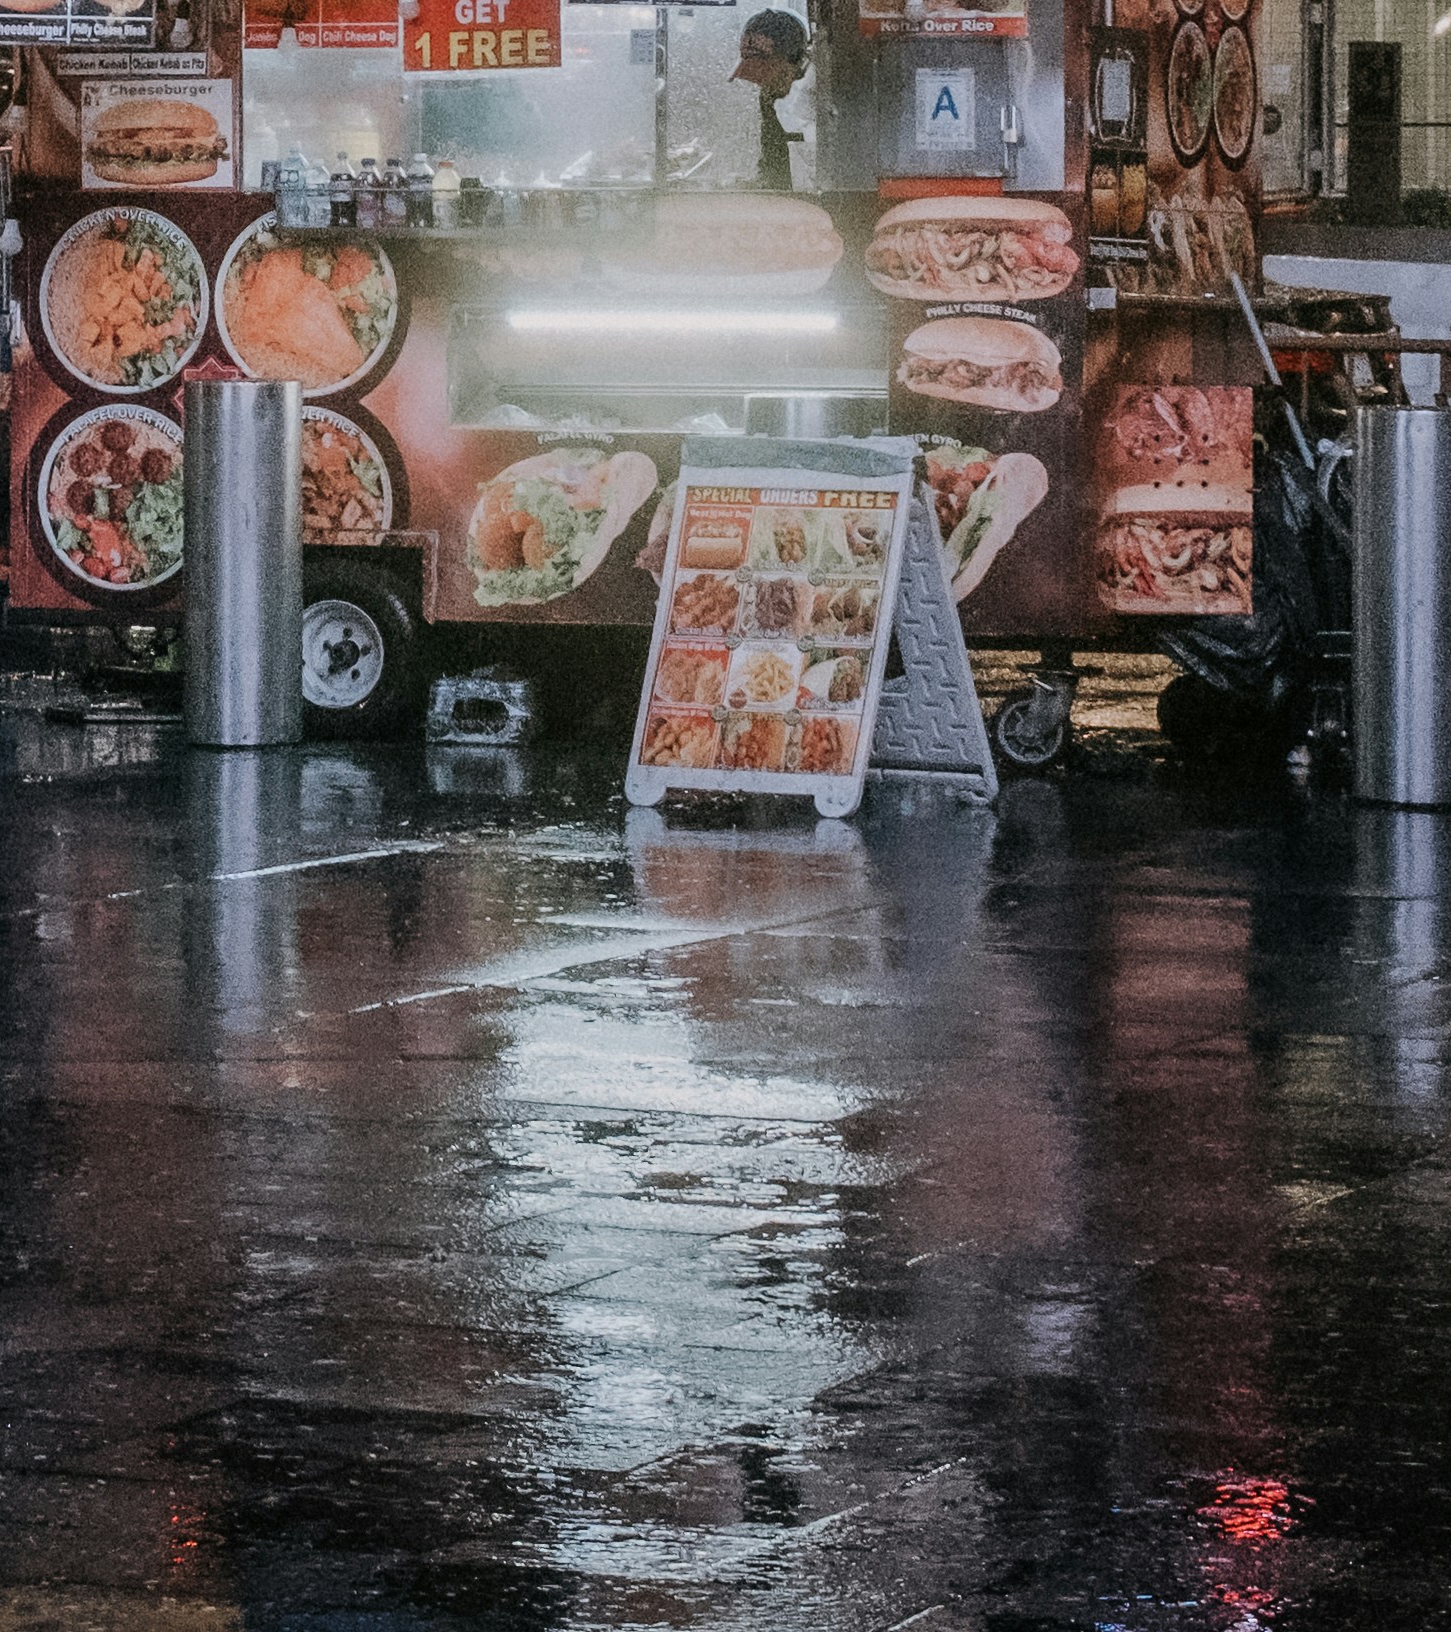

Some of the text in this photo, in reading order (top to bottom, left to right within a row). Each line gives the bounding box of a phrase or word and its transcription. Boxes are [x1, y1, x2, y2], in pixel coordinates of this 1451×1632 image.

[924, 20, 959, 33] Over
[961, 19, 995, 32] Rice
[379, 29, 397, 45] Dog
[414, 29, 551, 68] 1 FREE
[59, 58, 96, 70] Chicken
[109, 83, 214, 98] Cheeseburger
[931, 85, 960, 121] A
[256, 214, 279, 234] FIS
[925, 303, 962, 318] PHILLY
[962, 302, 1003, 316] CHEESE
